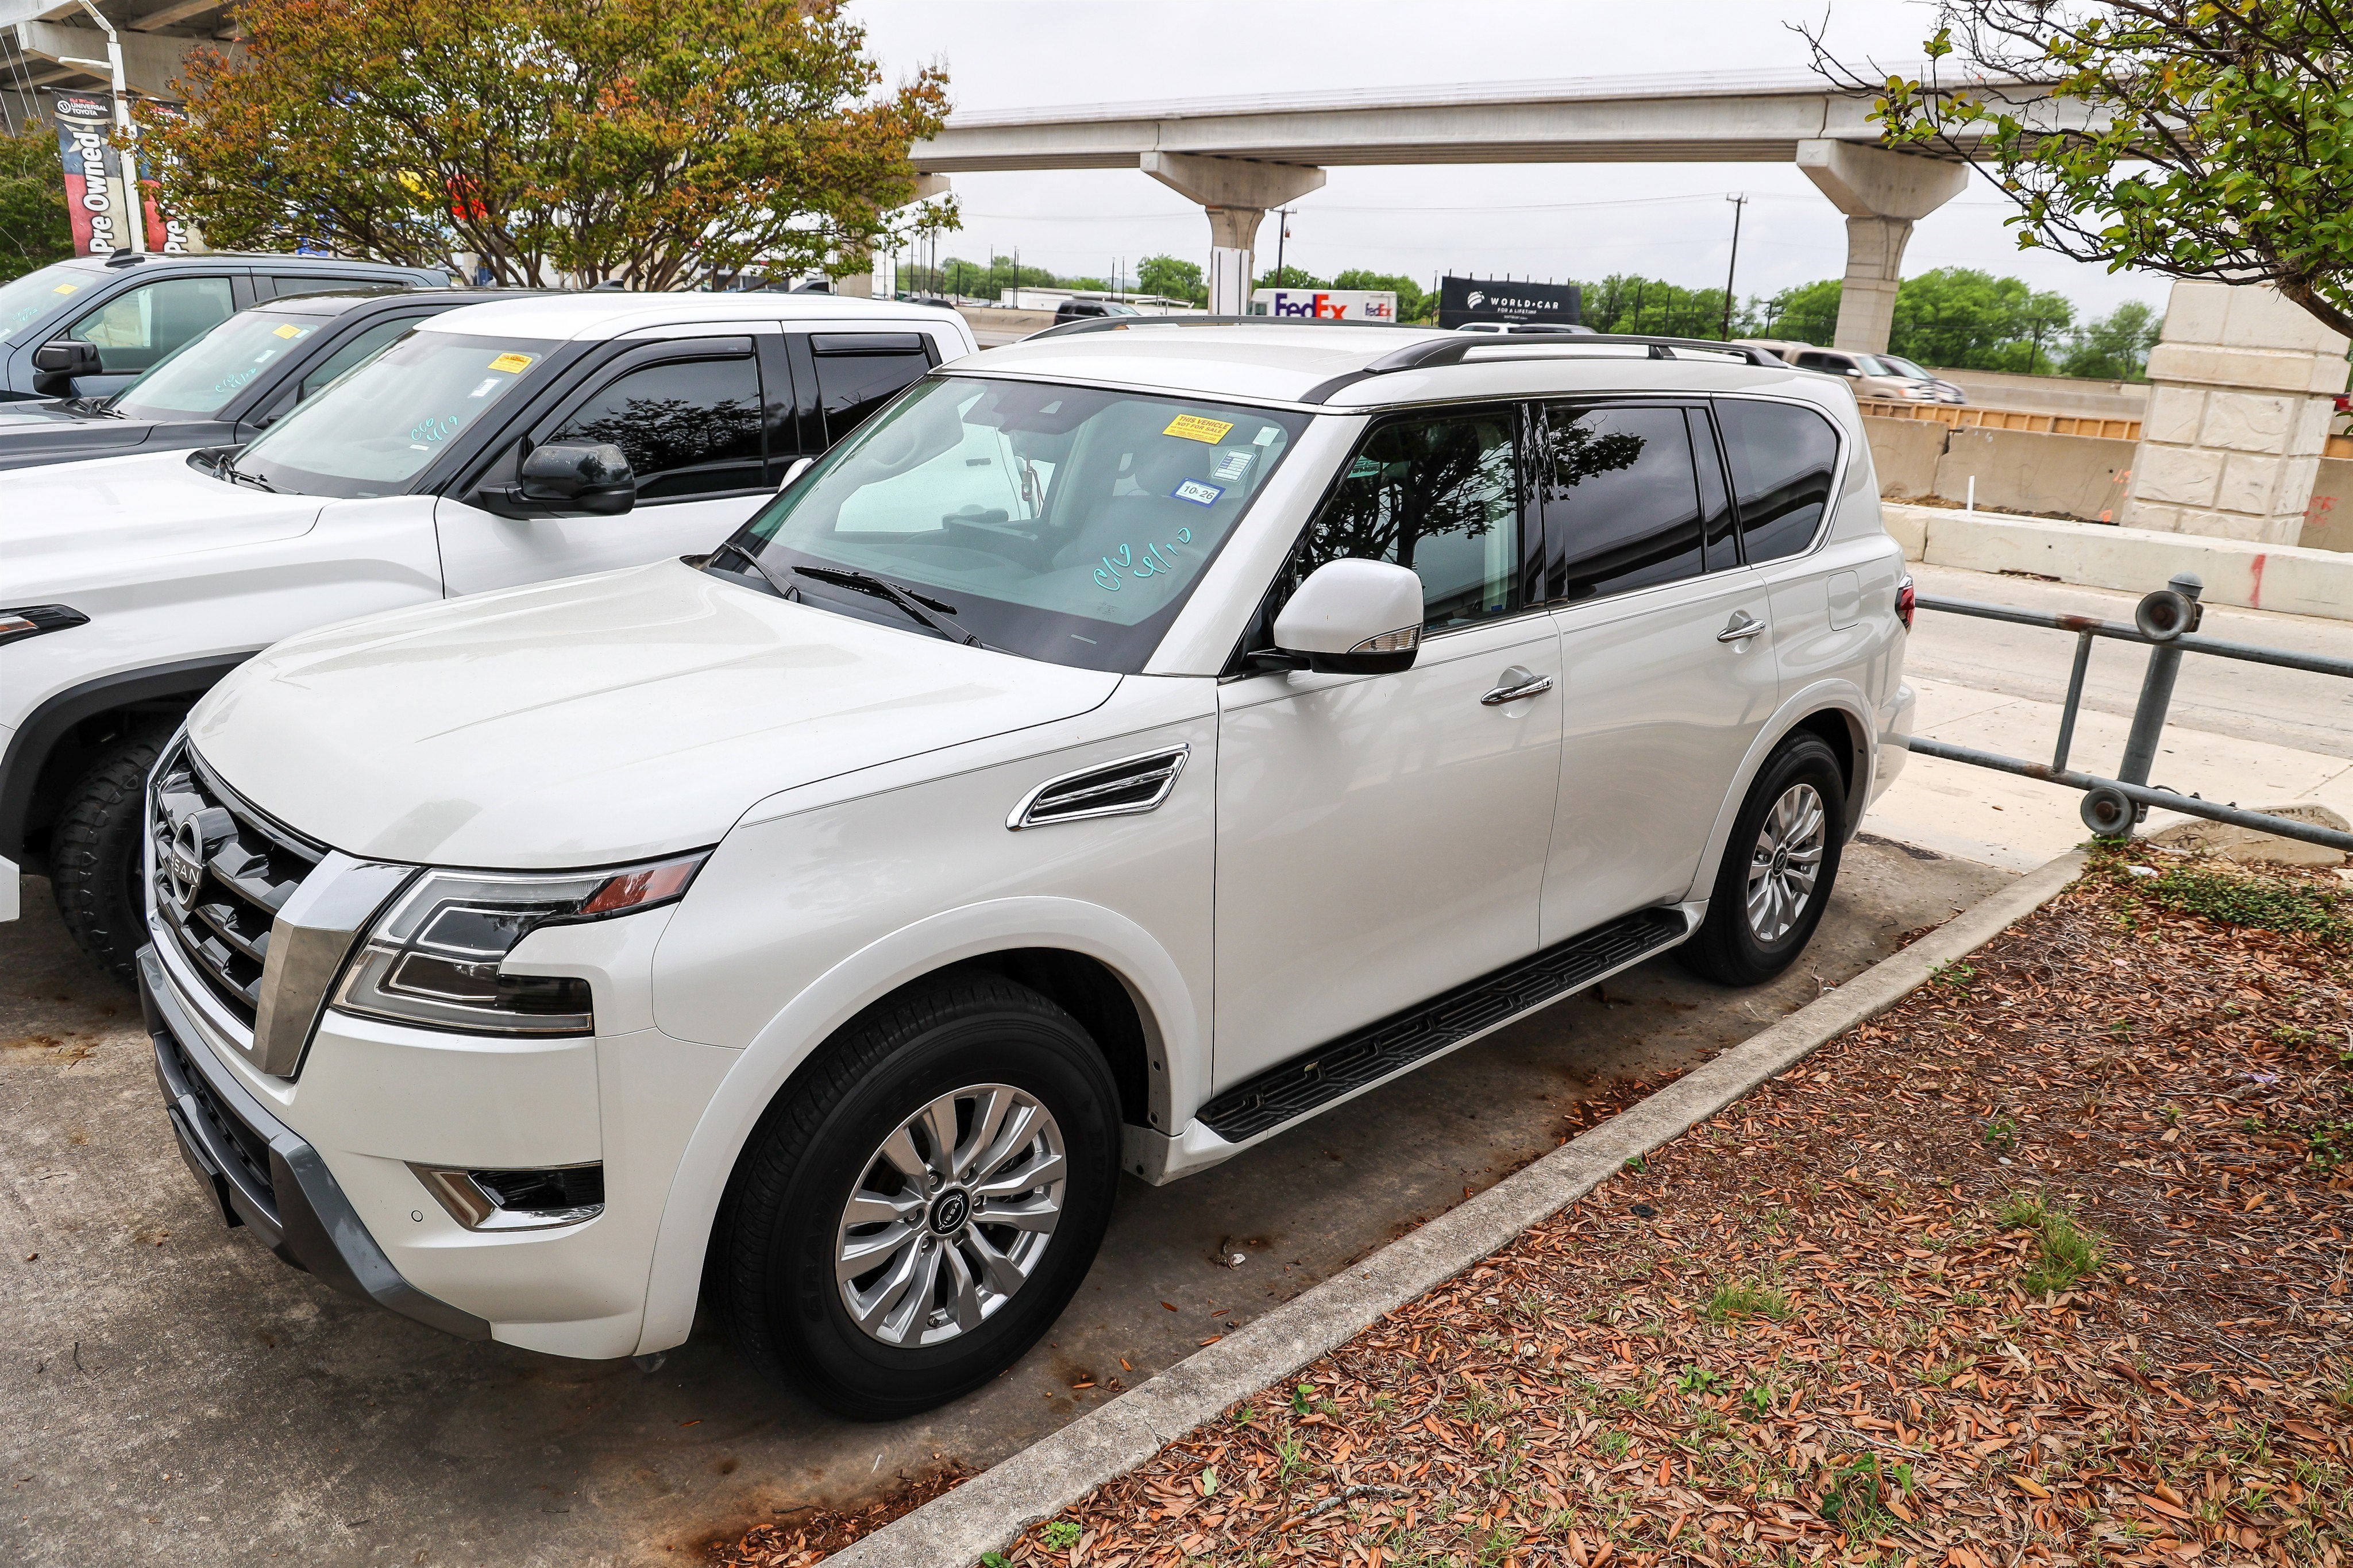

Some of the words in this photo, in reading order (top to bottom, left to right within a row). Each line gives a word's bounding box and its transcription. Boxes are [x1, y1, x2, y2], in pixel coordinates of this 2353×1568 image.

[70, 102, 108, 112] UNIVERSAL
[72, 108, 98, 116] TOYOTA
[72, 132, 110, 212] Owned
[90, 216, 115, 253] Pre
[1275, 293, 1348, 319] FedEx
[1365, 302, 1391, 316] FedEx
[1197, 419, 1229, 430] VEHICLE
[1184, 485, 1197, 494] 10
[1199, 490, 1215, 500] 26
[938, 1194, 963, 1230] NISSAN
